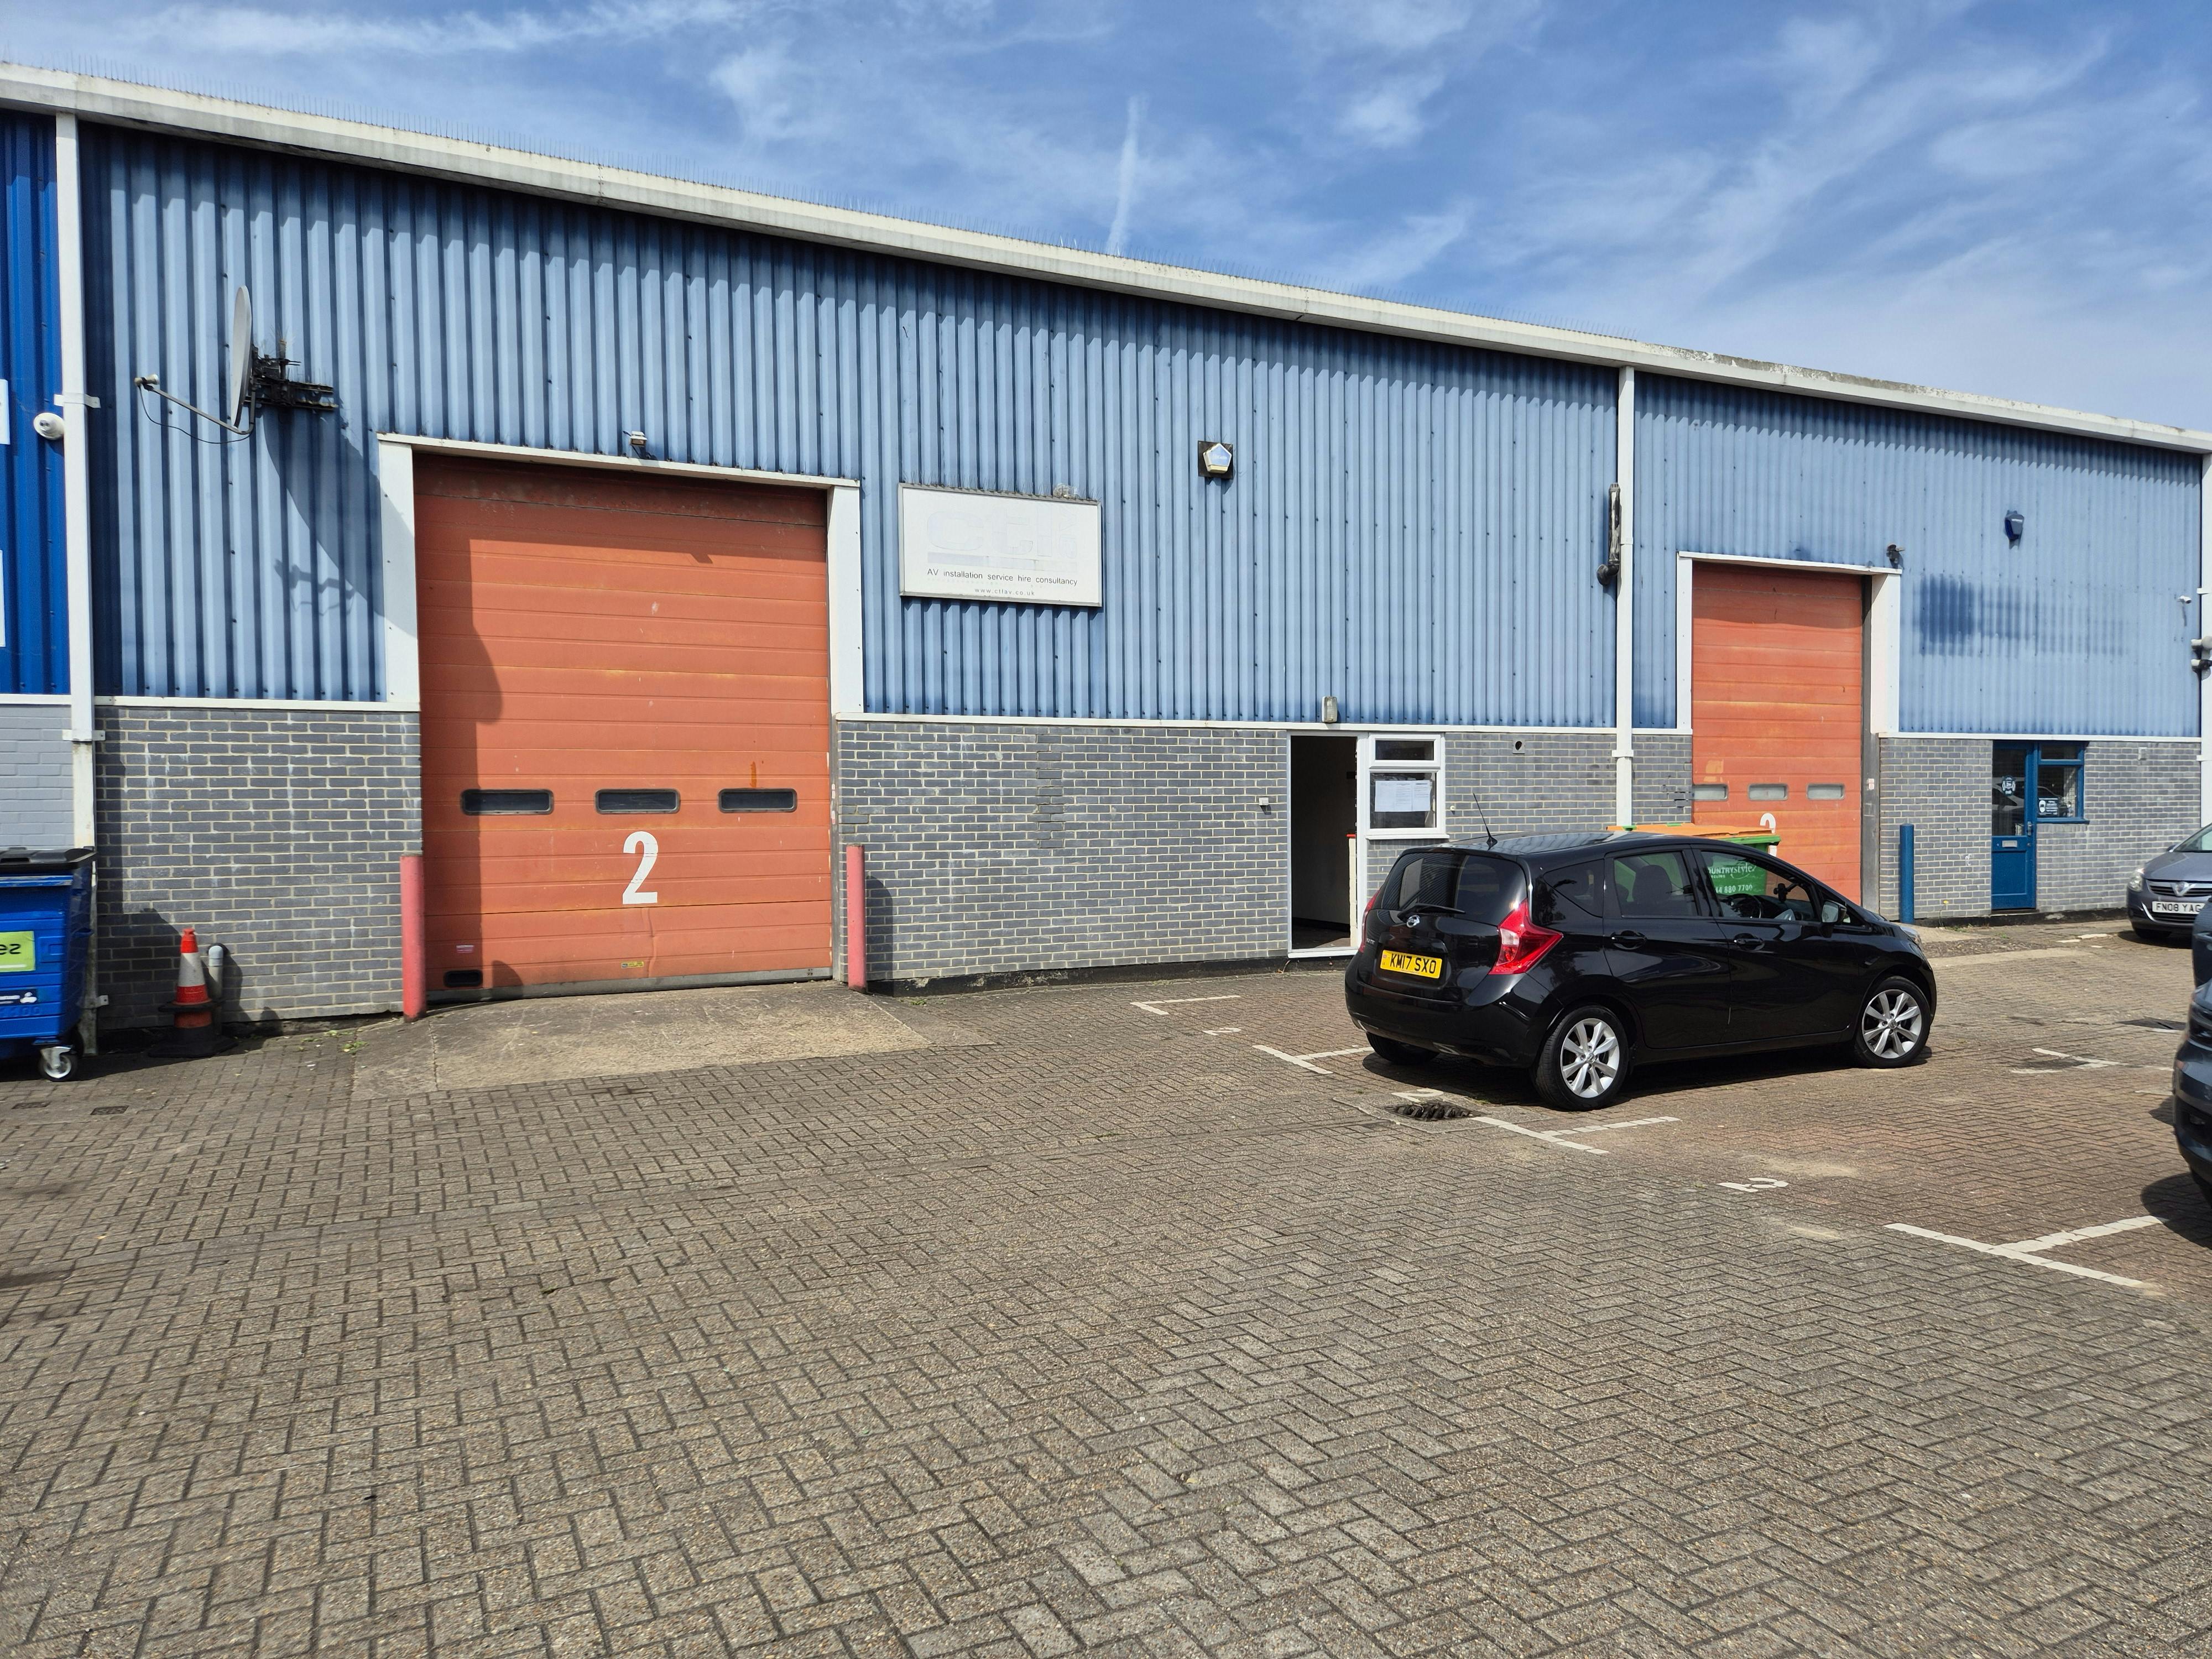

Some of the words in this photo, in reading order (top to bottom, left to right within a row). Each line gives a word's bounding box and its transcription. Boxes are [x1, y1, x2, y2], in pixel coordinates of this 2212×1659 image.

[943, 570, 983, 579] installation
[1035, 577, 1078, 587] consultancy
[974, 588, 1035, 596] www.ctlav.co.uk
[622, 831, 659, 905] 2
[1724, 885, 1736, 893] 880
[2156, 902, 2179, 912] FN08
[1390, 953, 1412, 970] KM17
[1414, 957, 1437, 974] SXO
